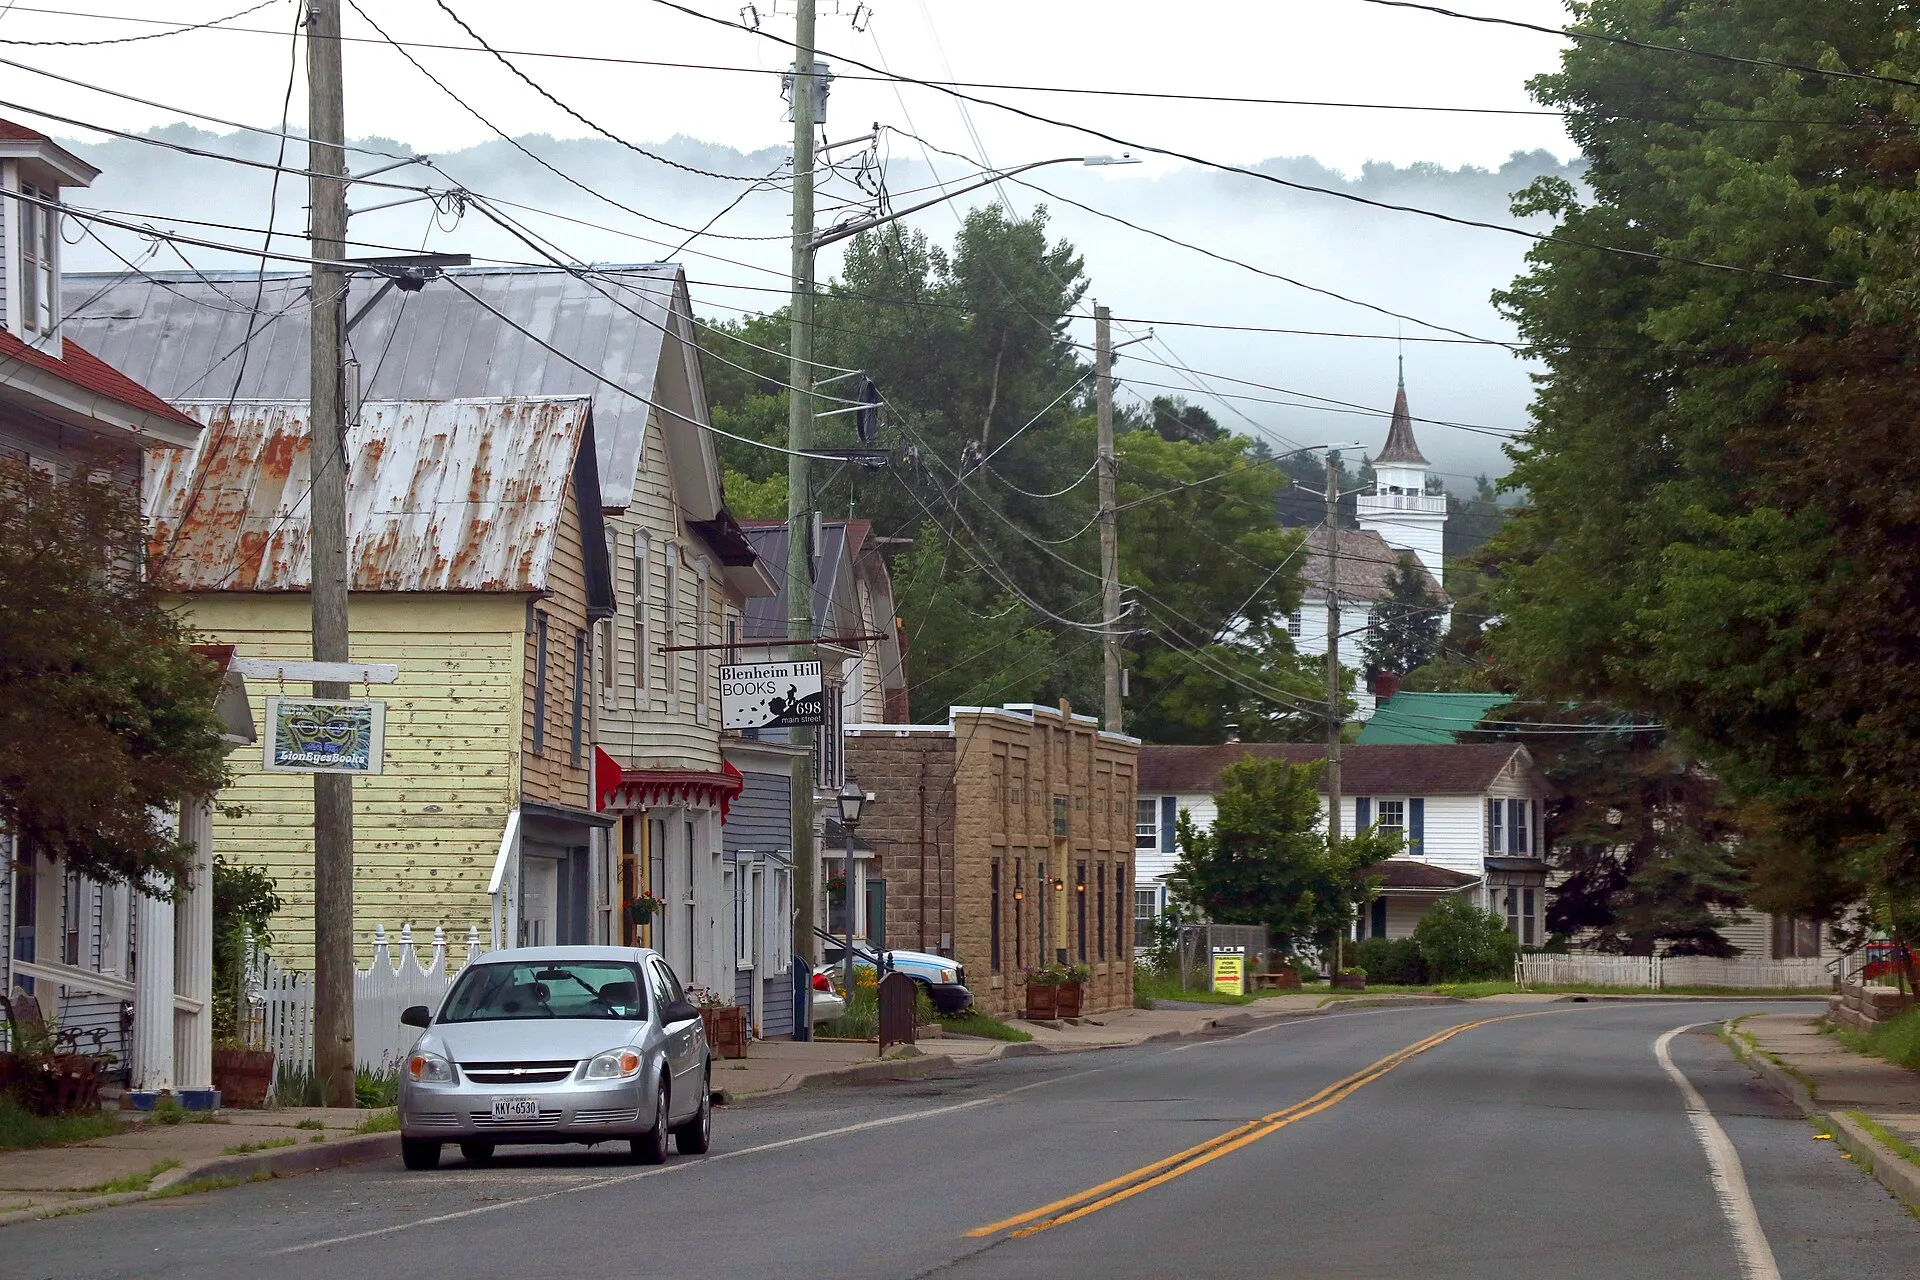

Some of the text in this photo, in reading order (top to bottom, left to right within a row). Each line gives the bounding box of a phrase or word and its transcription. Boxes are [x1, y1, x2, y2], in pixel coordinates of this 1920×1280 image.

[721, 663, 819, 680] Blenheim Hill
[723, 681, 776, 696] BOOKS
[796, 701, 821, 715] 698
[801, 715, 821, 723] street
[280, 751, 365, 764] LionEyesBooks
